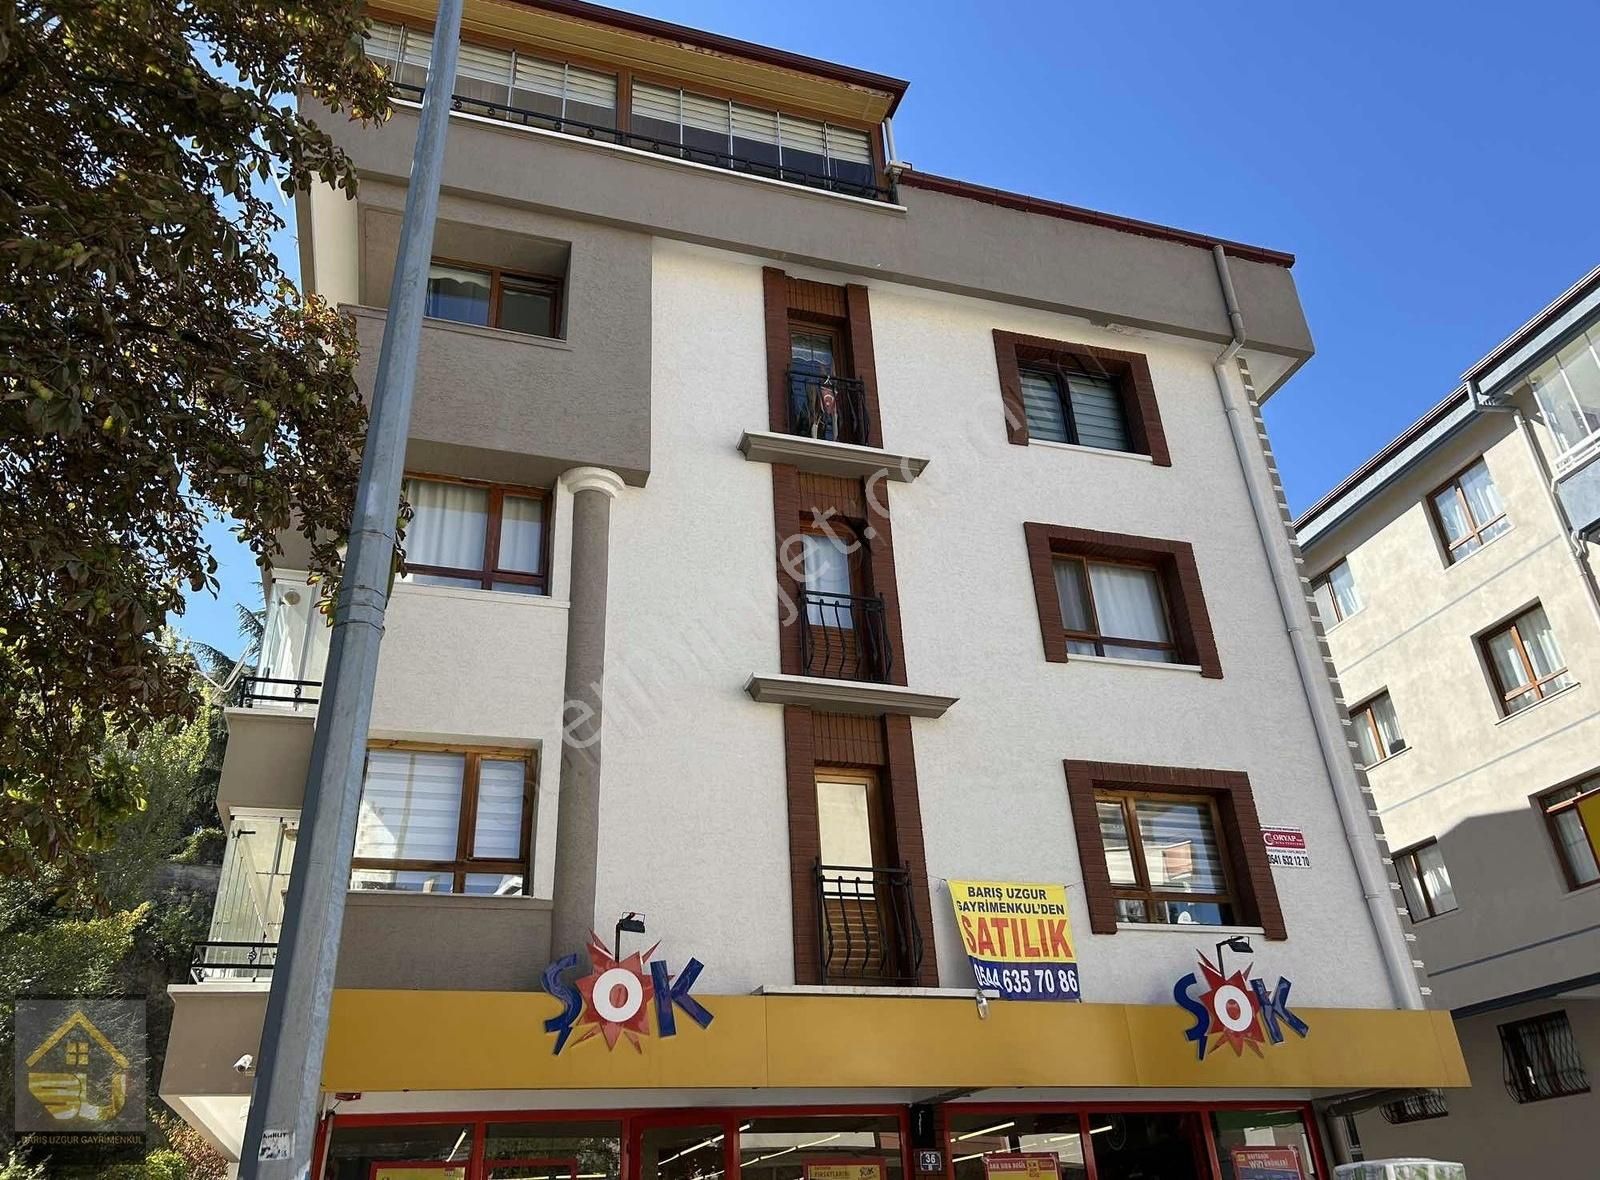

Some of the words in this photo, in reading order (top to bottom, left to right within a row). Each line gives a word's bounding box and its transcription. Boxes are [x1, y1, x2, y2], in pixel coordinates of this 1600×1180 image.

[1294, 856, 1302, 866] 12
[968, 886, 1003, 901] BARIŞ
[1006, 888, 1047, 900] UZGUR
[961, 915, 1073, 958] SATILIK
[973, 963, 1004, 990] 0544
[1002, 969, 1032, 993] 635
[1034, 969, 1055, 992] 70
[1057, 969, 1079, 992] 86
[540, 952, 715, 1057] ŞOK
[1173, 972, 1311, 1061] ŞOK
[925, 1153, 936, 1164] 36
